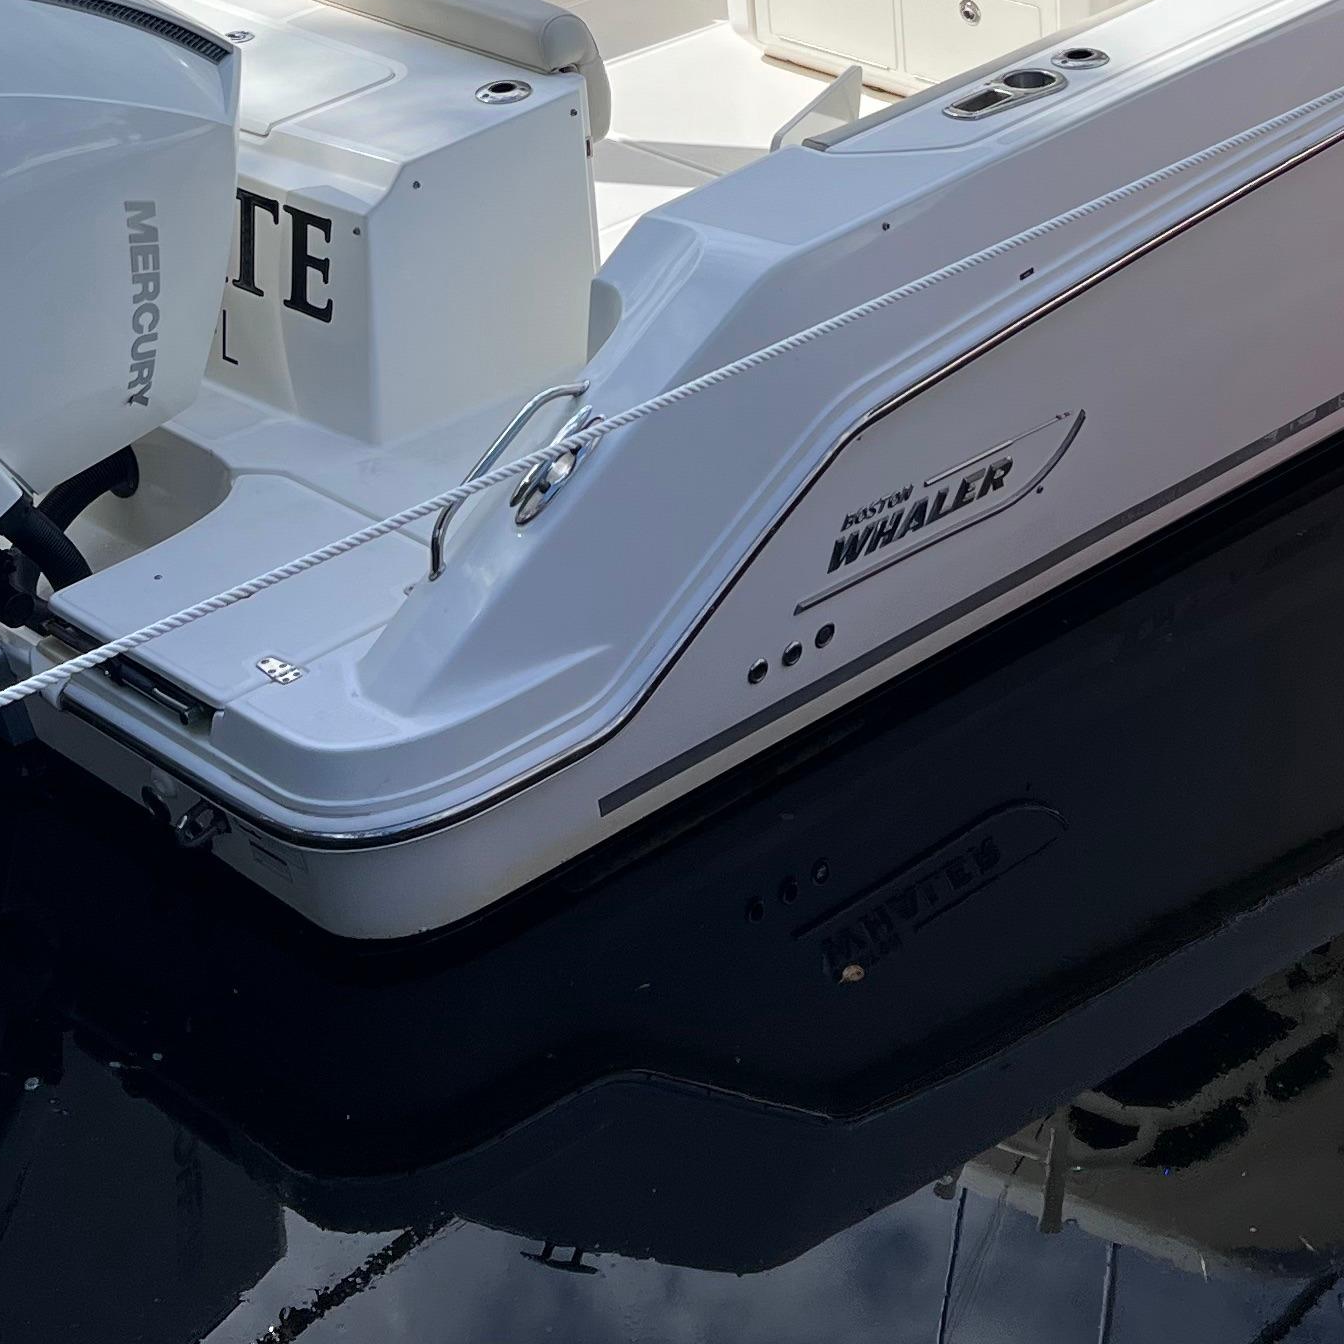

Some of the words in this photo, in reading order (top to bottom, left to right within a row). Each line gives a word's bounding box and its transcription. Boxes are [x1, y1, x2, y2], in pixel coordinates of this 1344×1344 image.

[123, 199, 160, 409] MERCURY
[226, 187, 333, 324] TE
[827, 456, 1014, 575] WHALER
[840, 484, 914, 532] BOSTON
